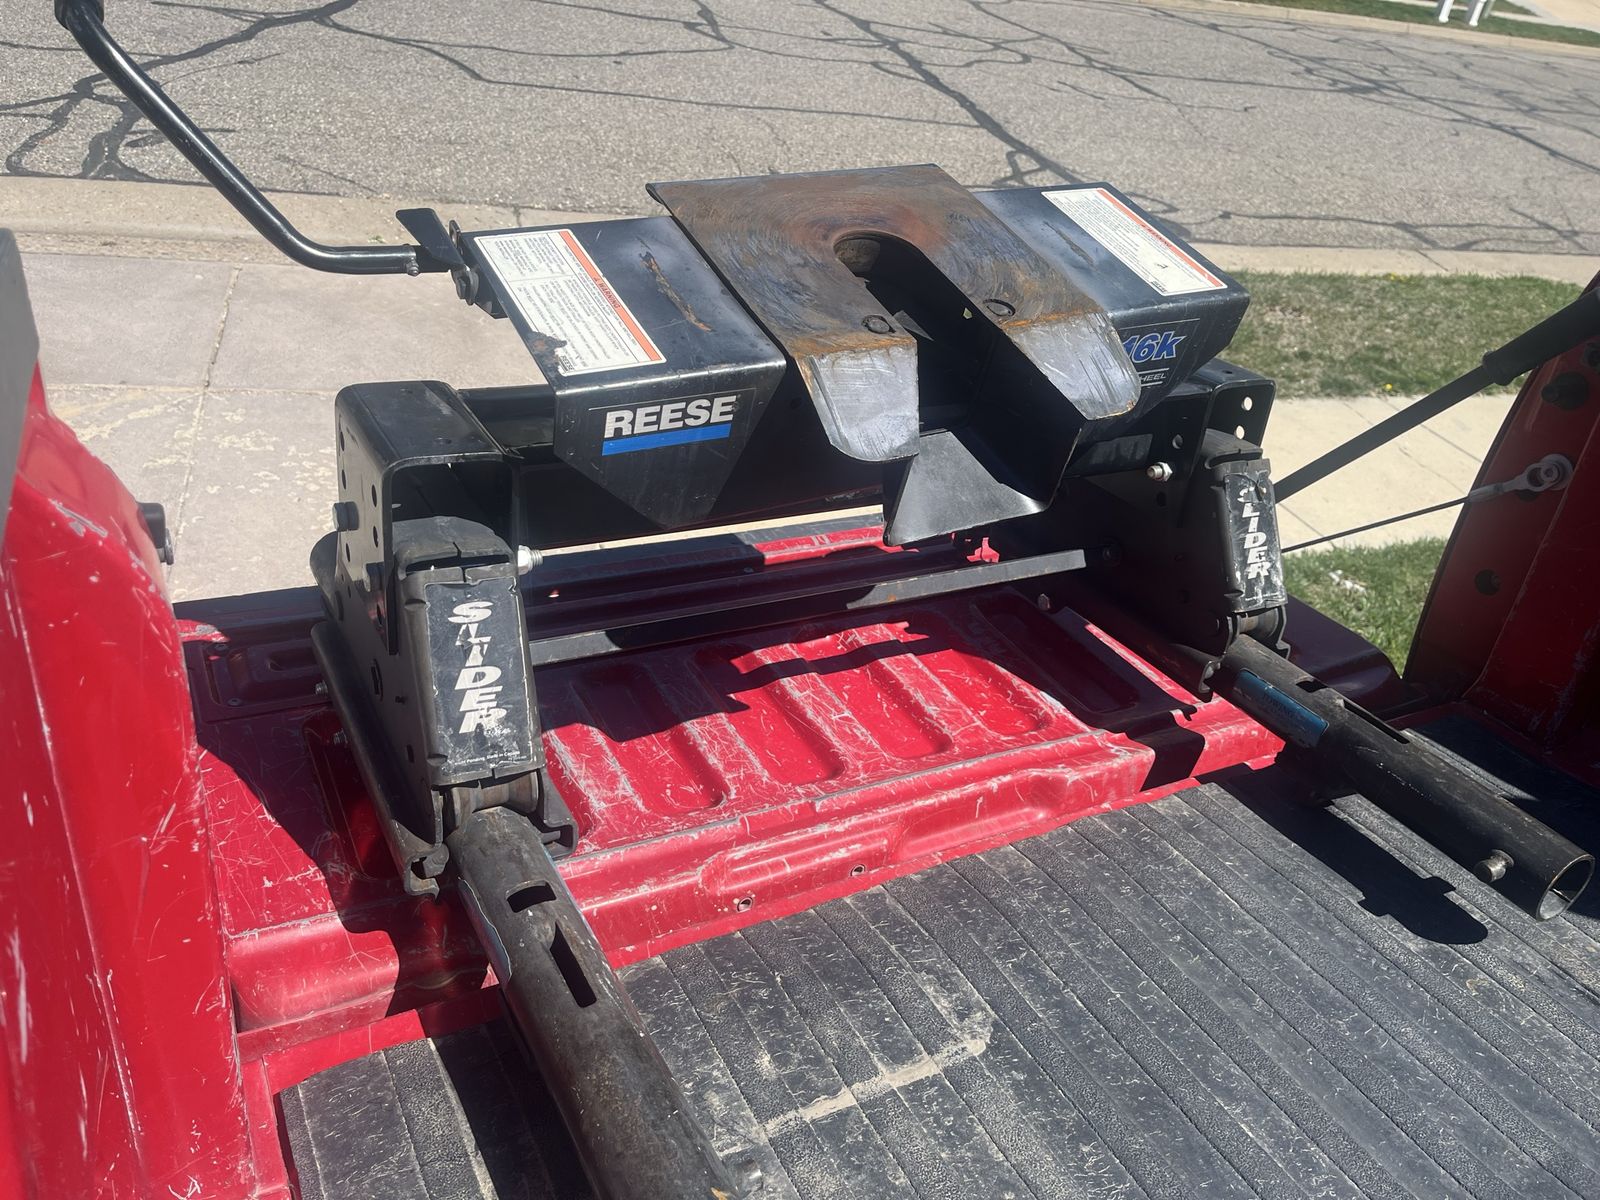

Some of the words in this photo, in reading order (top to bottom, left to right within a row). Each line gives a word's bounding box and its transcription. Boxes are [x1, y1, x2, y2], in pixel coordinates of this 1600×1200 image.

[598, 282, 621, 309] WARNING
[1123, 331, 1187, 363] 16k
[1139, 373, 1166, 382] HEEL
[604, 395, 737, 439] REESE
[1236, 486, 1271, 580] SLIDER
[447, 601, 507, 735] SLIDER
